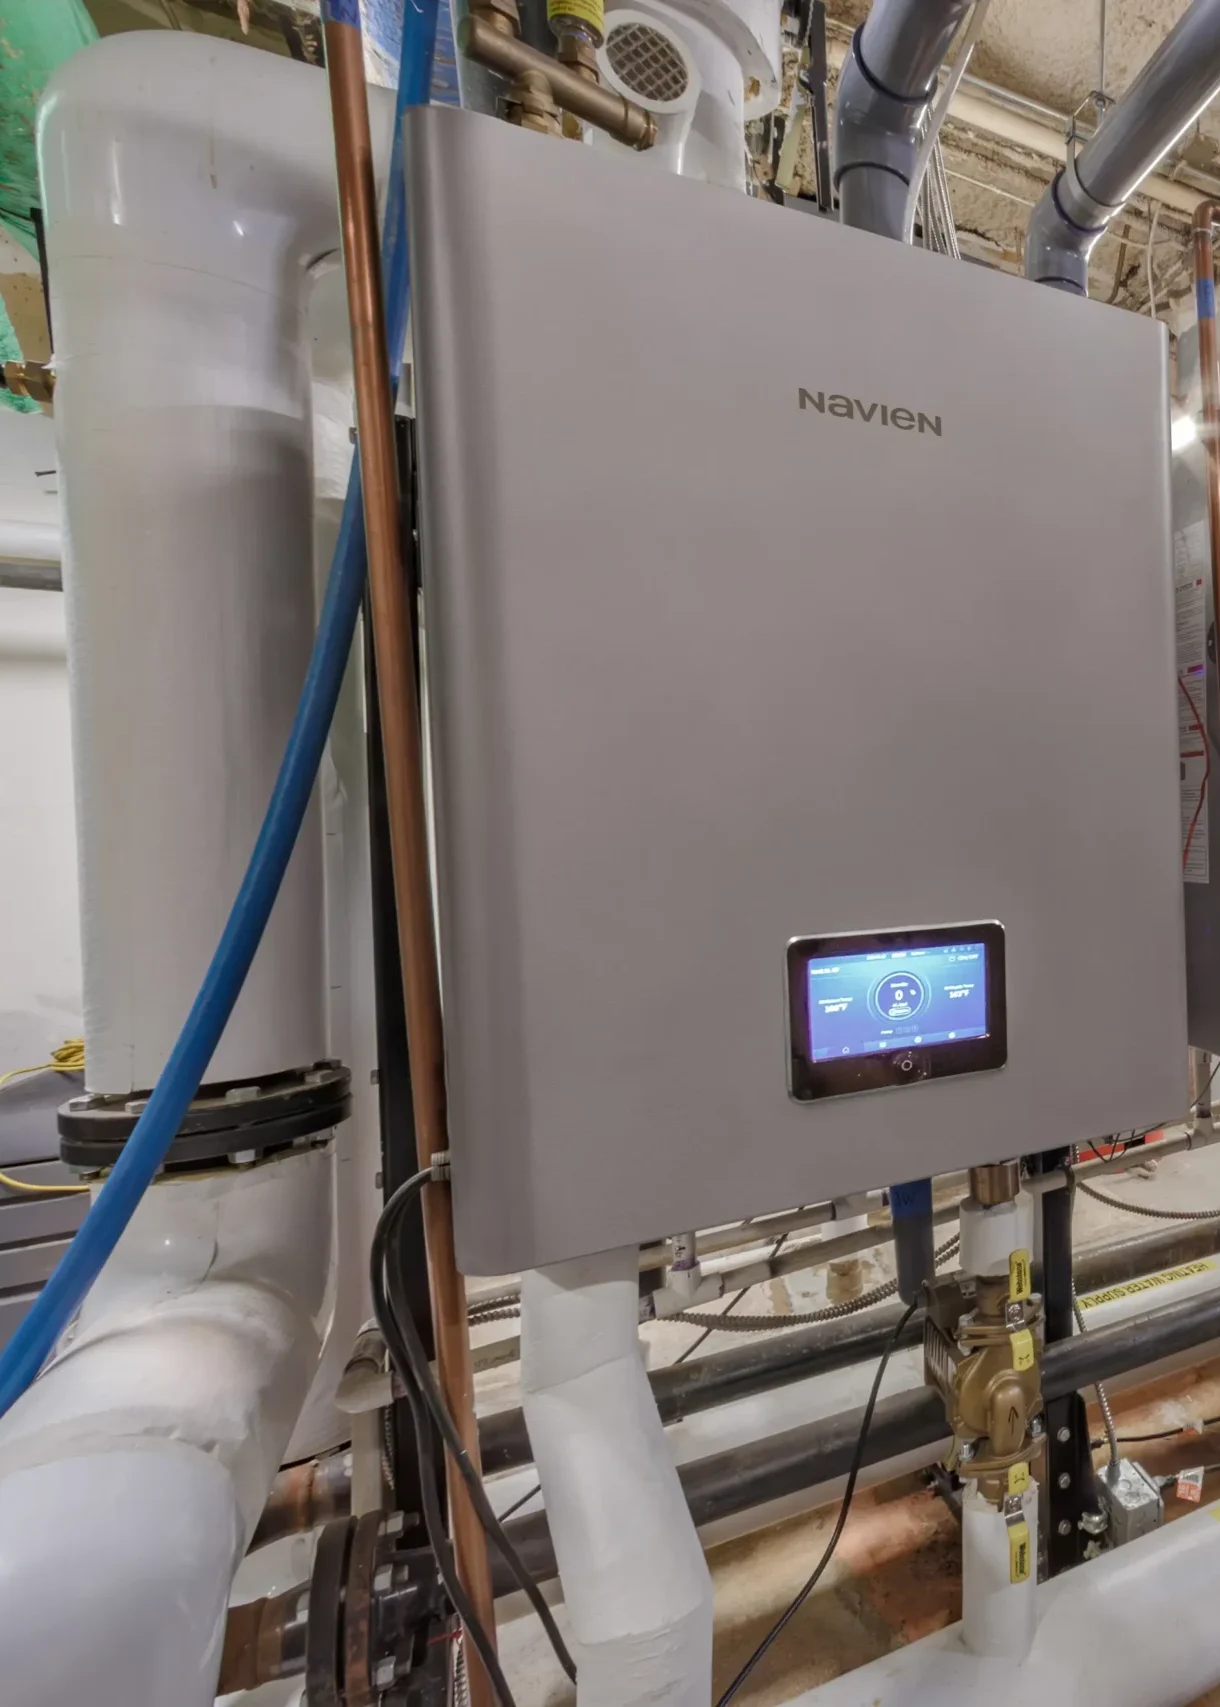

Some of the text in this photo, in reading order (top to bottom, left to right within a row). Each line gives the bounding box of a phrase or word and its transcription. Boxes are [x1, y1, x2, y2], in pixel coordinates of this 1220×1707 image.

[895, 989, 903, 1001] 0
[1083, 1262, 1209, 1309] HEATING WATER SUPPLY
